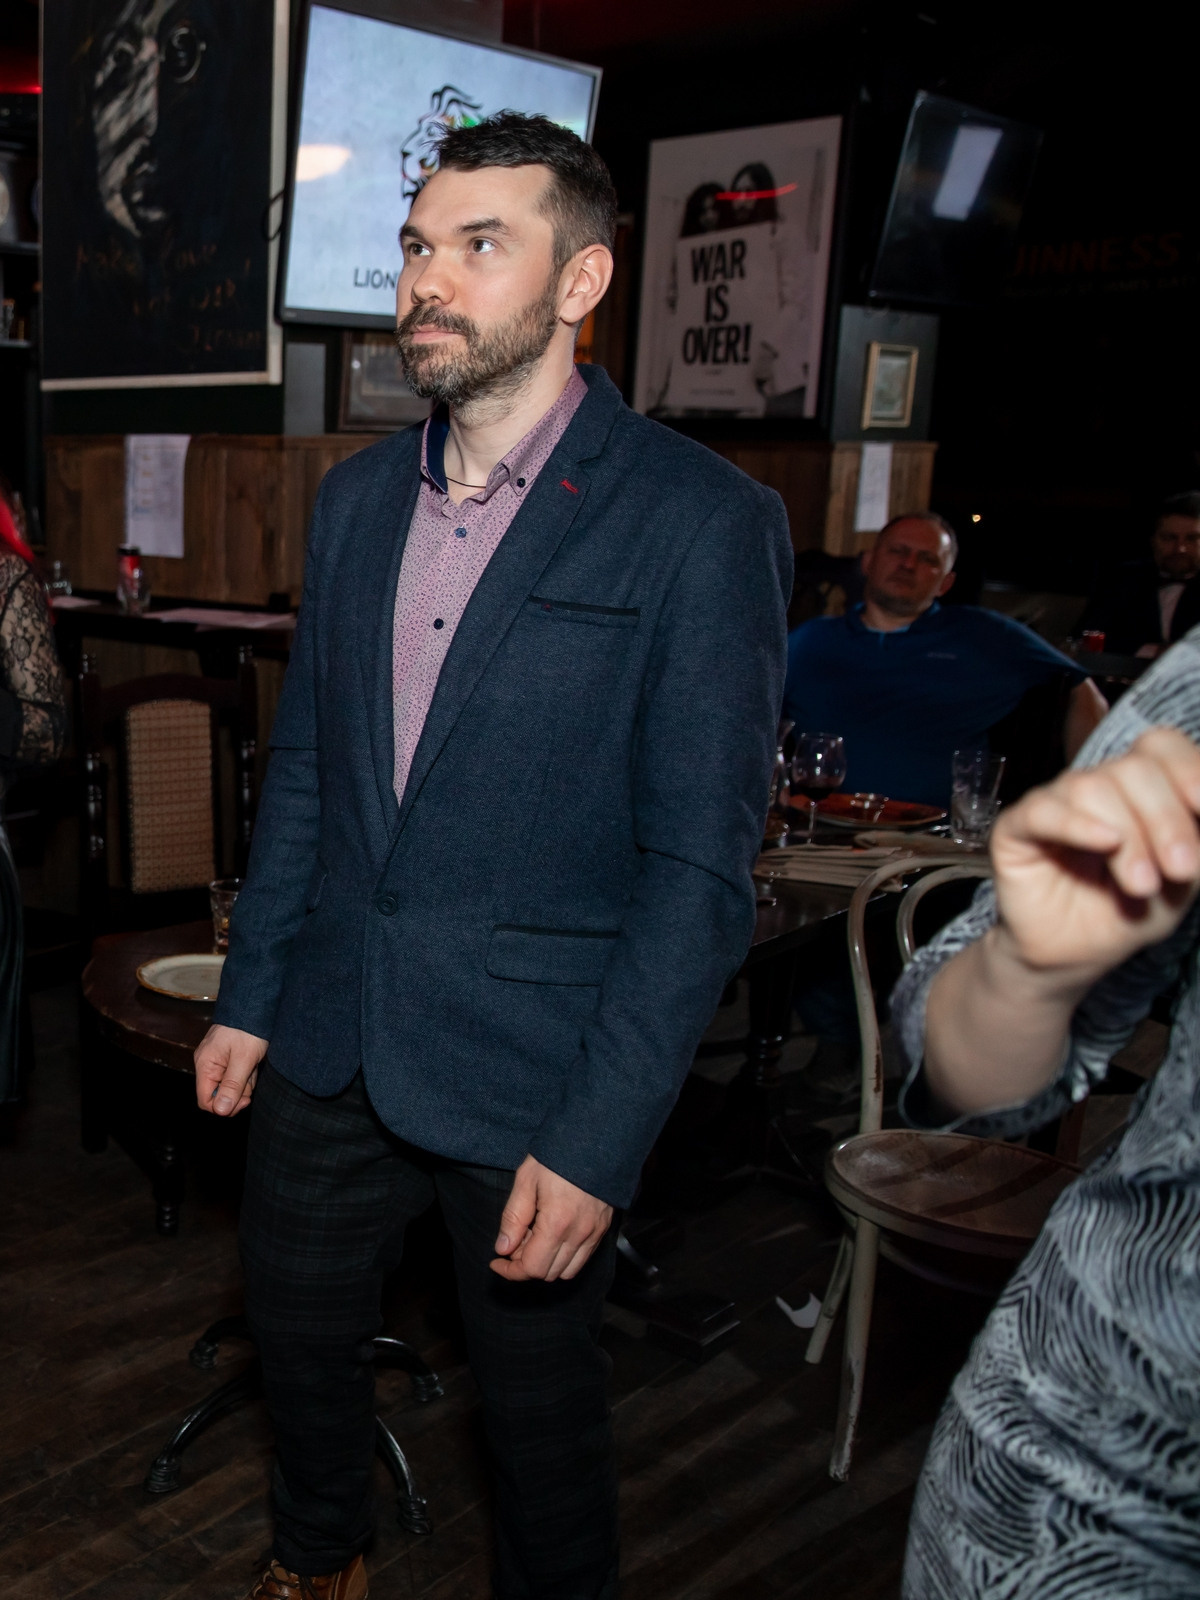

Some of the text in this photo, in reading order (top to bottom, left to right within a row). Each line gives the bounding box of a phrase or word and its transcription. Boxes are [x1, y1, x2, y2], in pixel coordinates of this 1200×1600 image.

[691, 239, 747, 284] WAR
[1003, 231, 1155, 279] INNESS
[354, 268, 398, 290] LION
[704, 284, 729, 324] IS
[683, 322, 751, 364] OVER!
